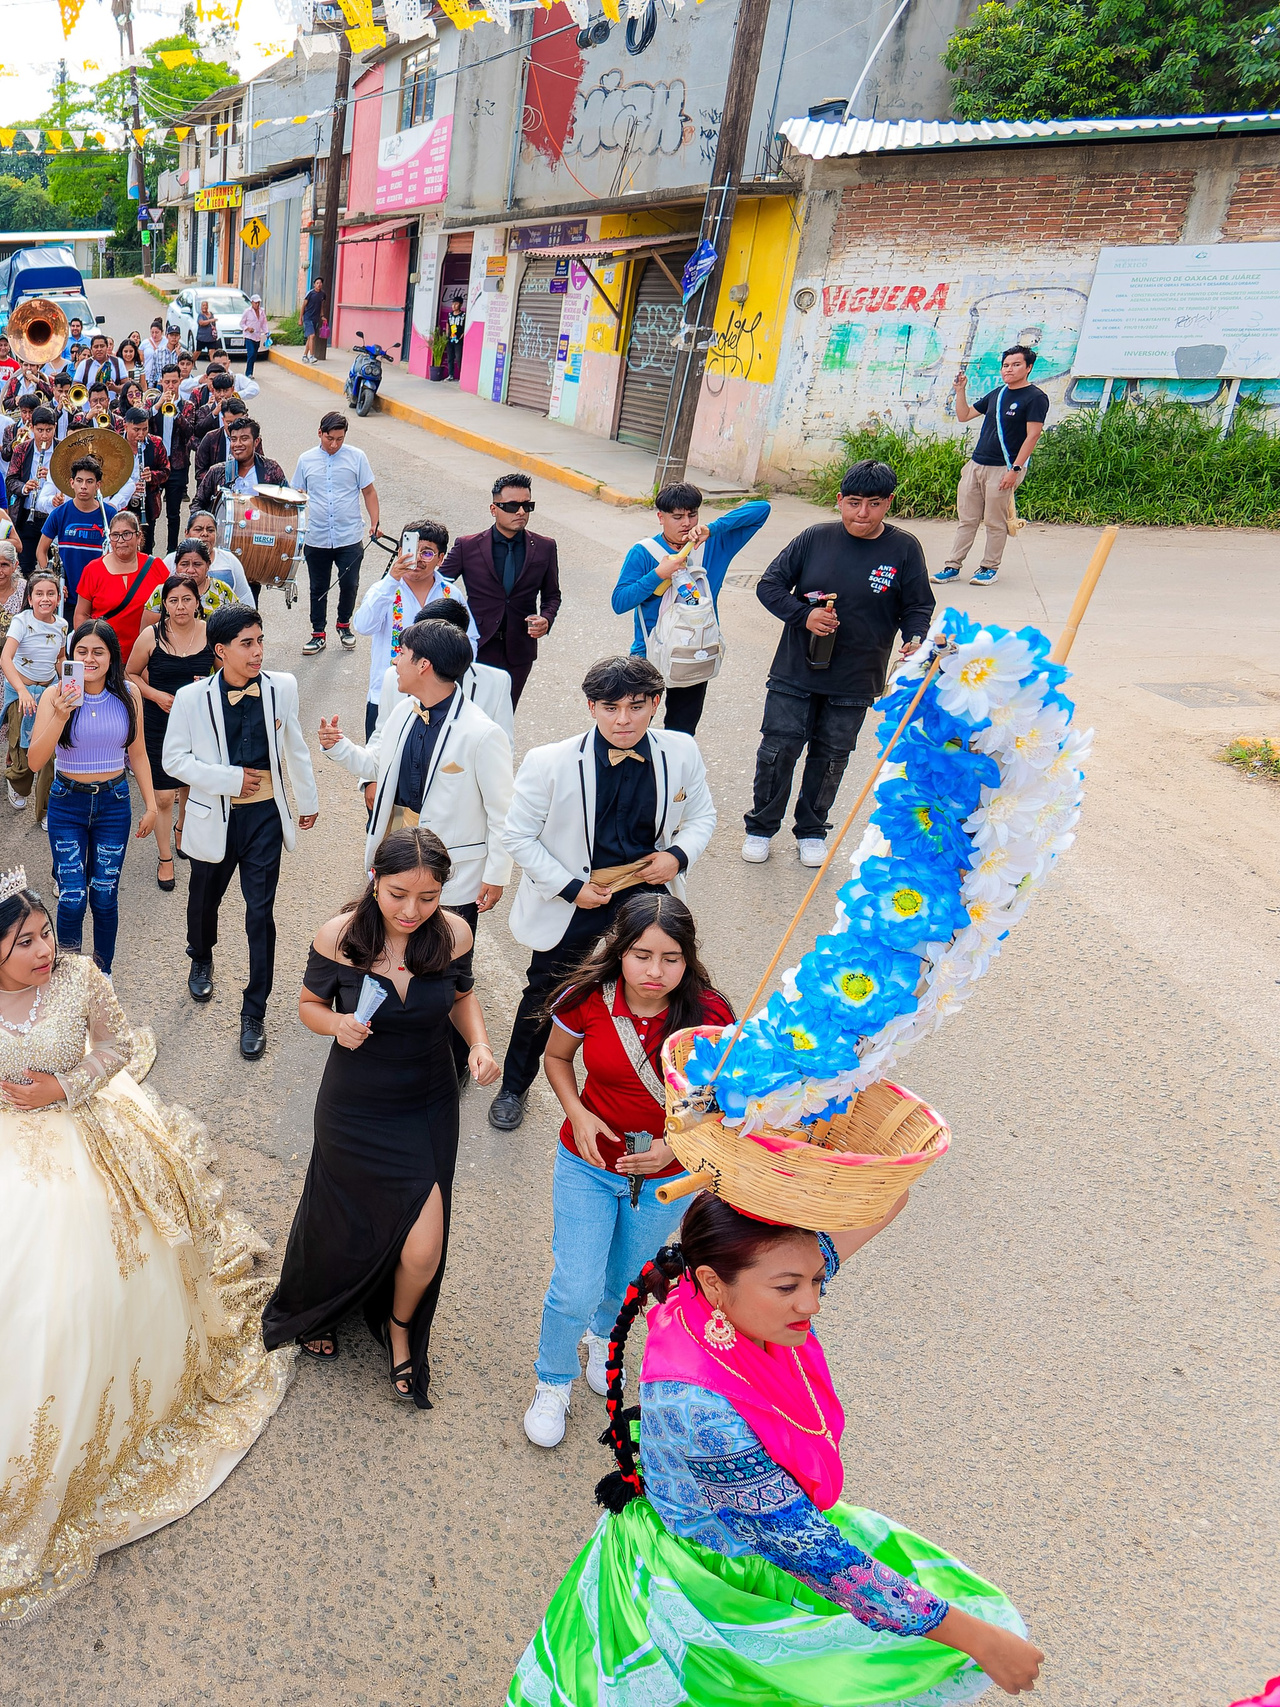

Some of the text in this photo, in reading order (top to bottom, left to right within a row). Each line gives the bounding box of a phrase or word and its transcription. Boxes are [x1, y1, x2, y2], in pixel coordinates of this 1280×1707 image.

[204, 186, 234, 199] UNIFORMES
[822, 283, 950, 318] VIGUERA
[868, 575, 891, 588] SOCIAL
